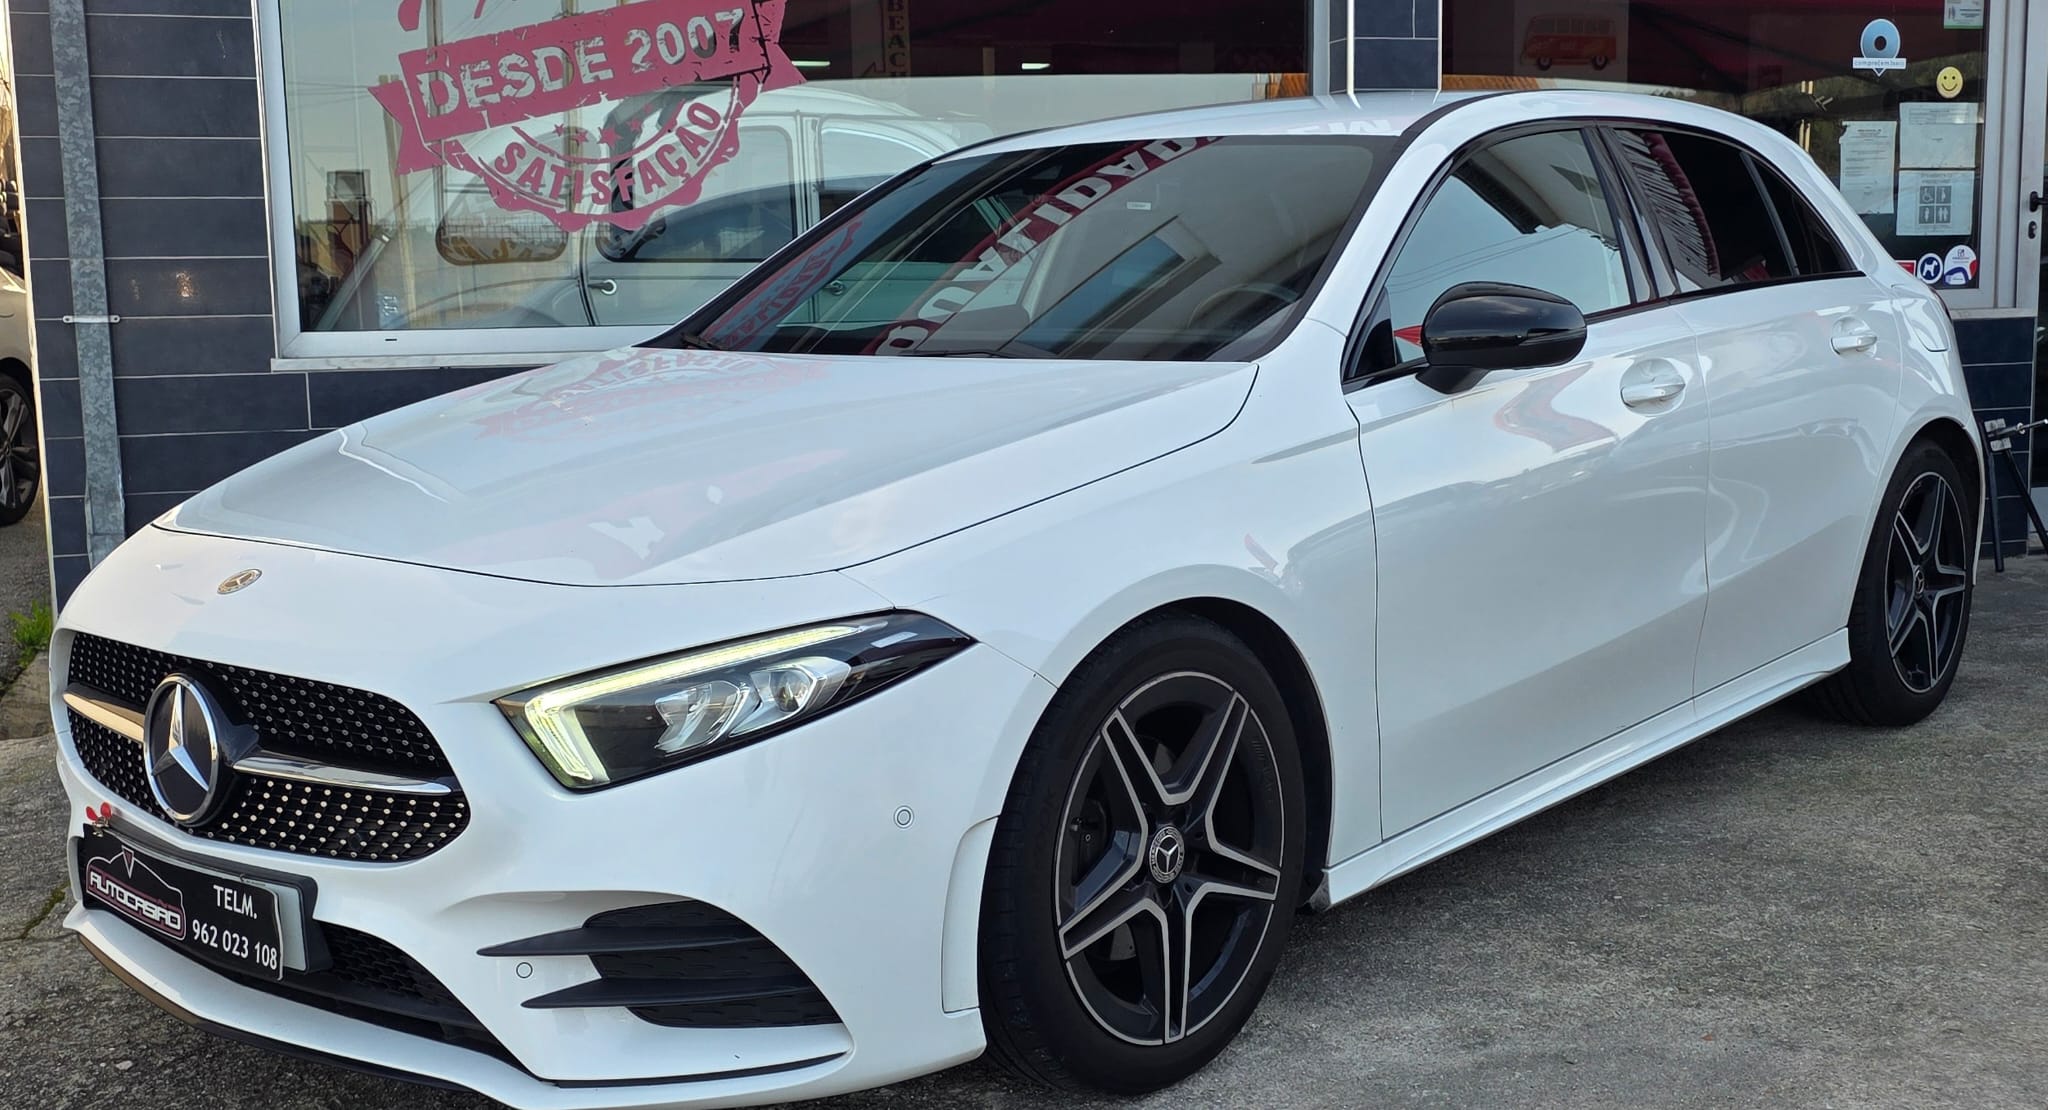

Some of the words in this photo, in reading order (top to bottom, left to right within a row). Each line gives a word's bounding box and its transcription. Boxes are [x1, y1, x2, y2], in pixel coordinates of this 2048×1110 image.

[416, 37, 614, 118] DESDE
[624, 8, 744, 74] 2007
[213, 884, 257, 919] TELM.
[192, 919, 218, 948] 962
[222, 930, 249, 958] 023
[254, 941, 277, 970] 108
